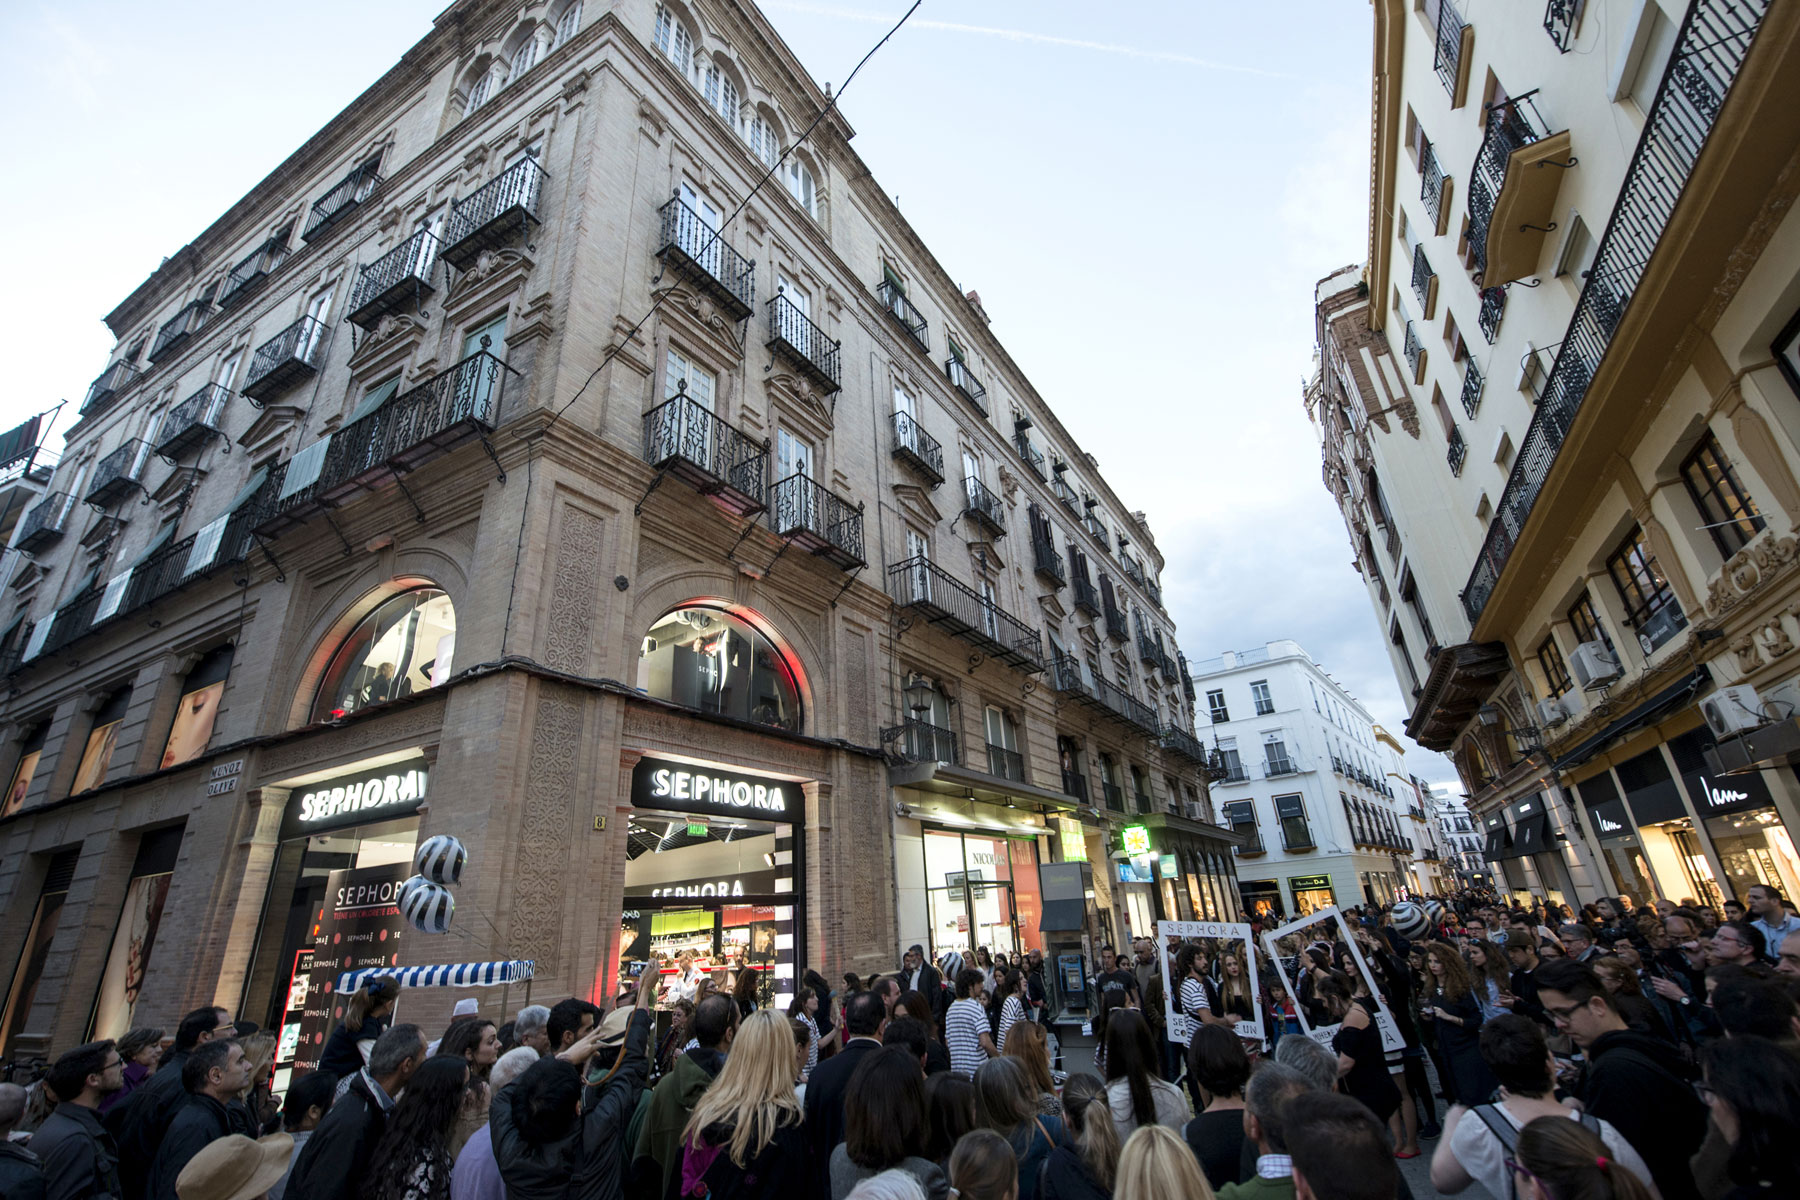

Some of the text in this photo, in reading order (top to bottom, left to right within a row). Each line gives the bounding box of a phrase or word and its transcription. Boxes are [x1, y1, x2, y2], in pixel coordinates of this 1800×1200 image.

[655, 769, 785, 811] SEPHORA
[299, 770, 419, 820] SEPHORA
[597, 817, 603, 828] 8
[336, 881, 403, 906] SEPHOR
[1168, 923, 1240, 935] SEPHORA
[347, 934, 370, 942] SEPHORA
[314, 960, 335, 968] SEPHORA
[358, 958, 380, 966] SEPHORA
[304, 1009, 326, 1017] SEPHORA
[294, 1060, 316, 1068] SEPHORA
